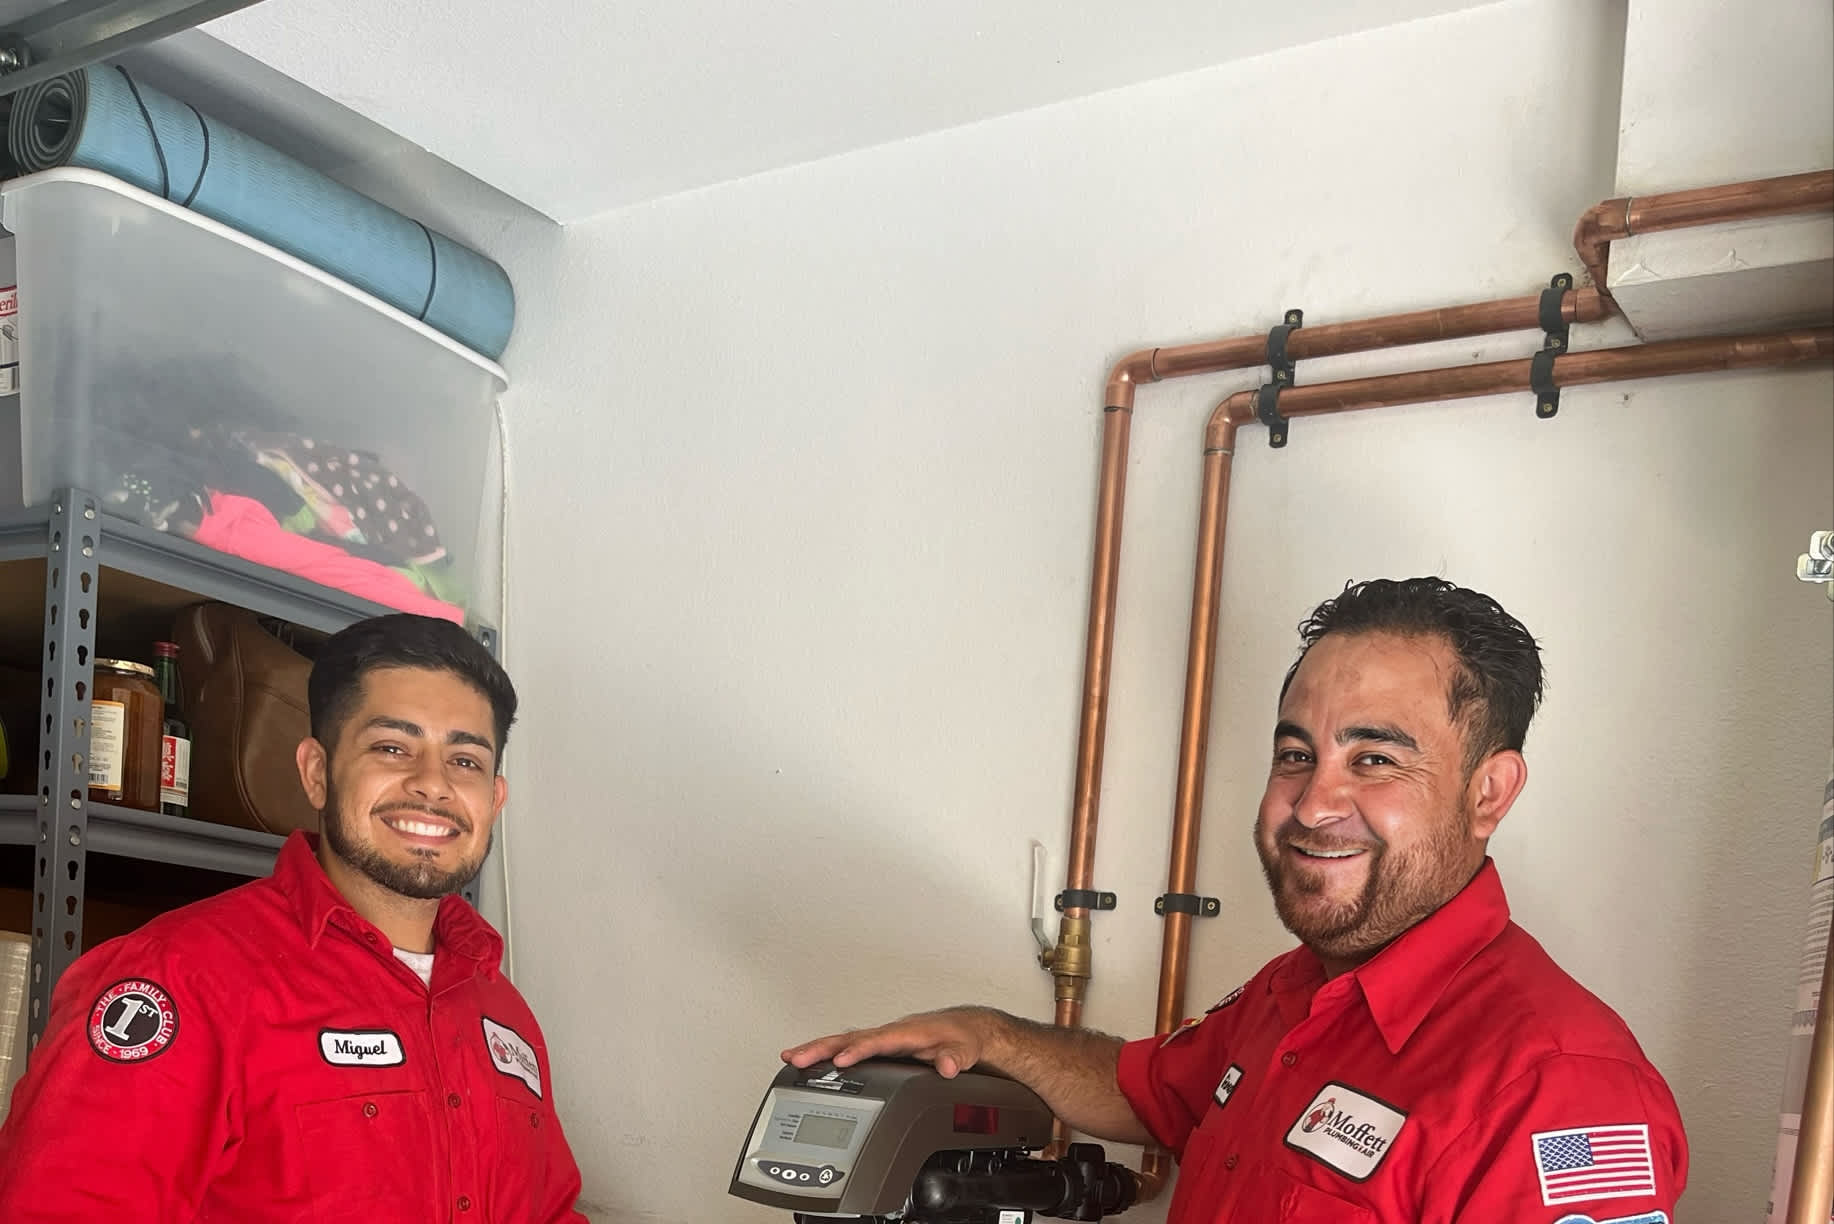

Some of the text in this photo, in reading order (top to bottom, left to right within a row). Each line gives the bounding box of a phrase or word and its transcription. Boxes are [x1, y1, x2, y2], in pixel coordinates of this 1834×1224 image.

[96, 982, 174, 1045] THE FAMILY CLUB
[92, 1024, 149, 1059] SINCE 1969
[334, 1039, 388, 1060] Miguel
[1323, 1126, 1359, 1151] PLUMBING
[1328, 1110, 1387, 1153] Moffett
